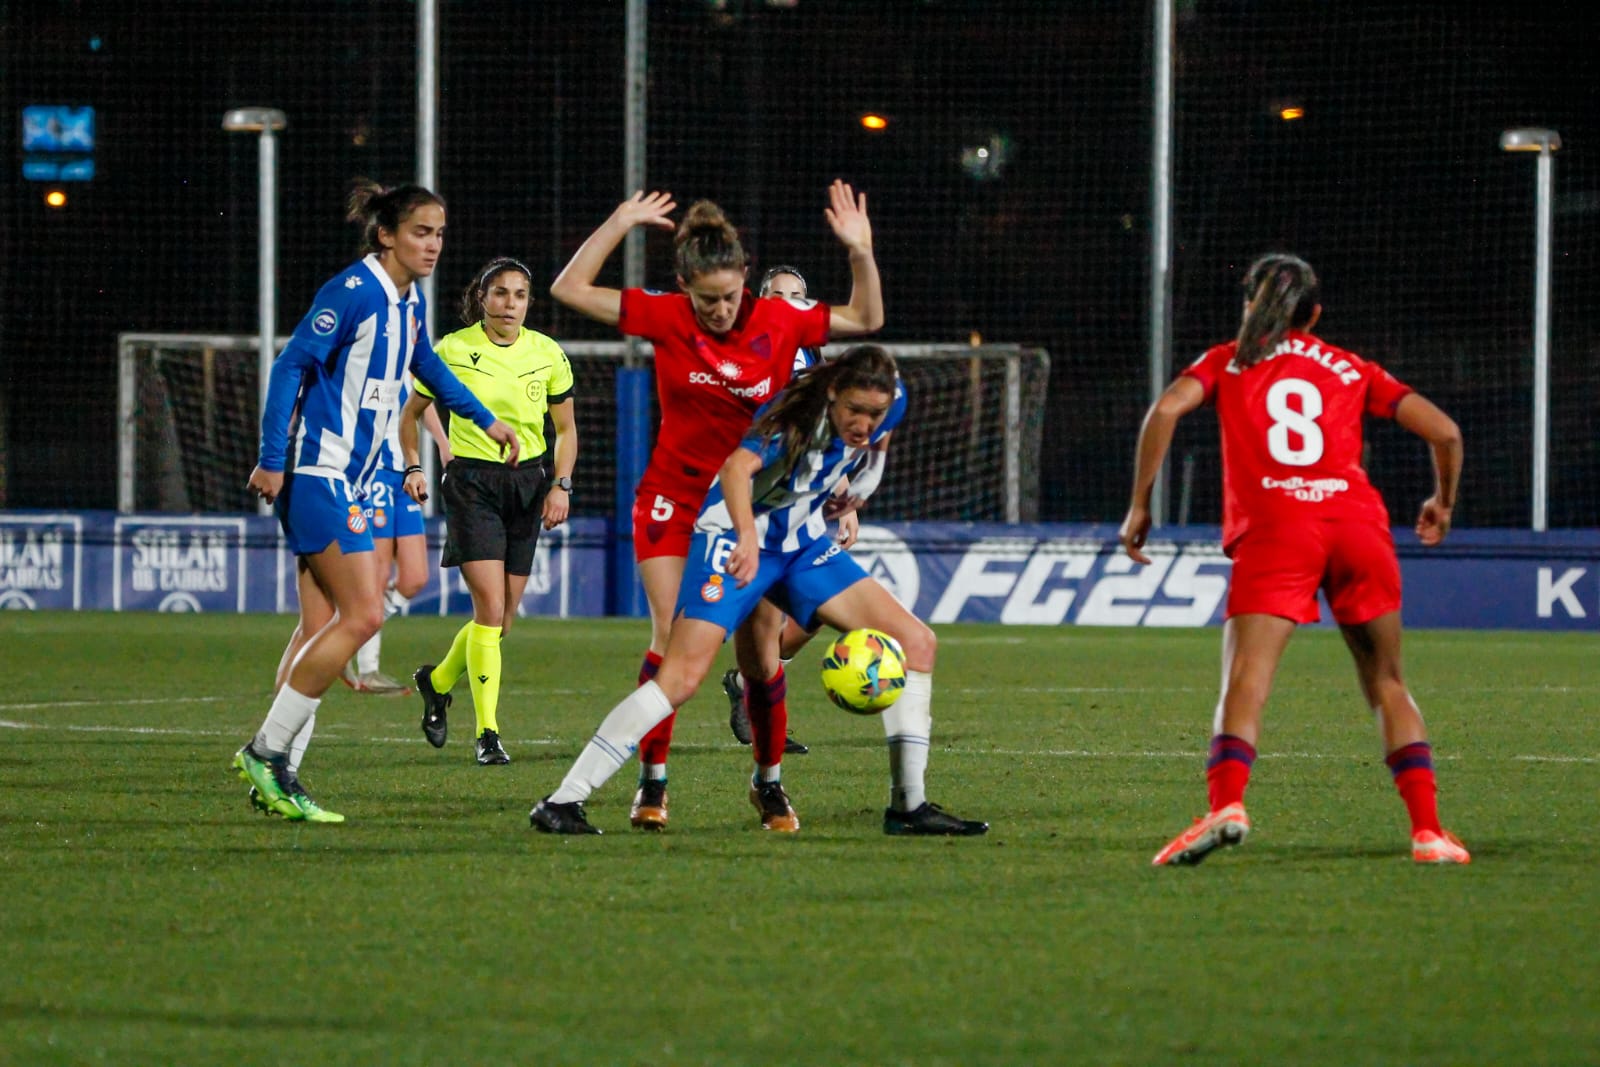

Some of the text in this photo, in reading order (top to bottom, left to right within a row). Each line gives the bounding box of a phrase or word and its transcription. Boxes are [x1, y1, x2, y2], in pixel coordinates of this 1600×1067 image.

[1266, 377, 1324, 467] 8
[651, 494, 674, 522] 5
[132, 530, 227, 569] SOLAN
[1537, 567, 1587, 618] K
